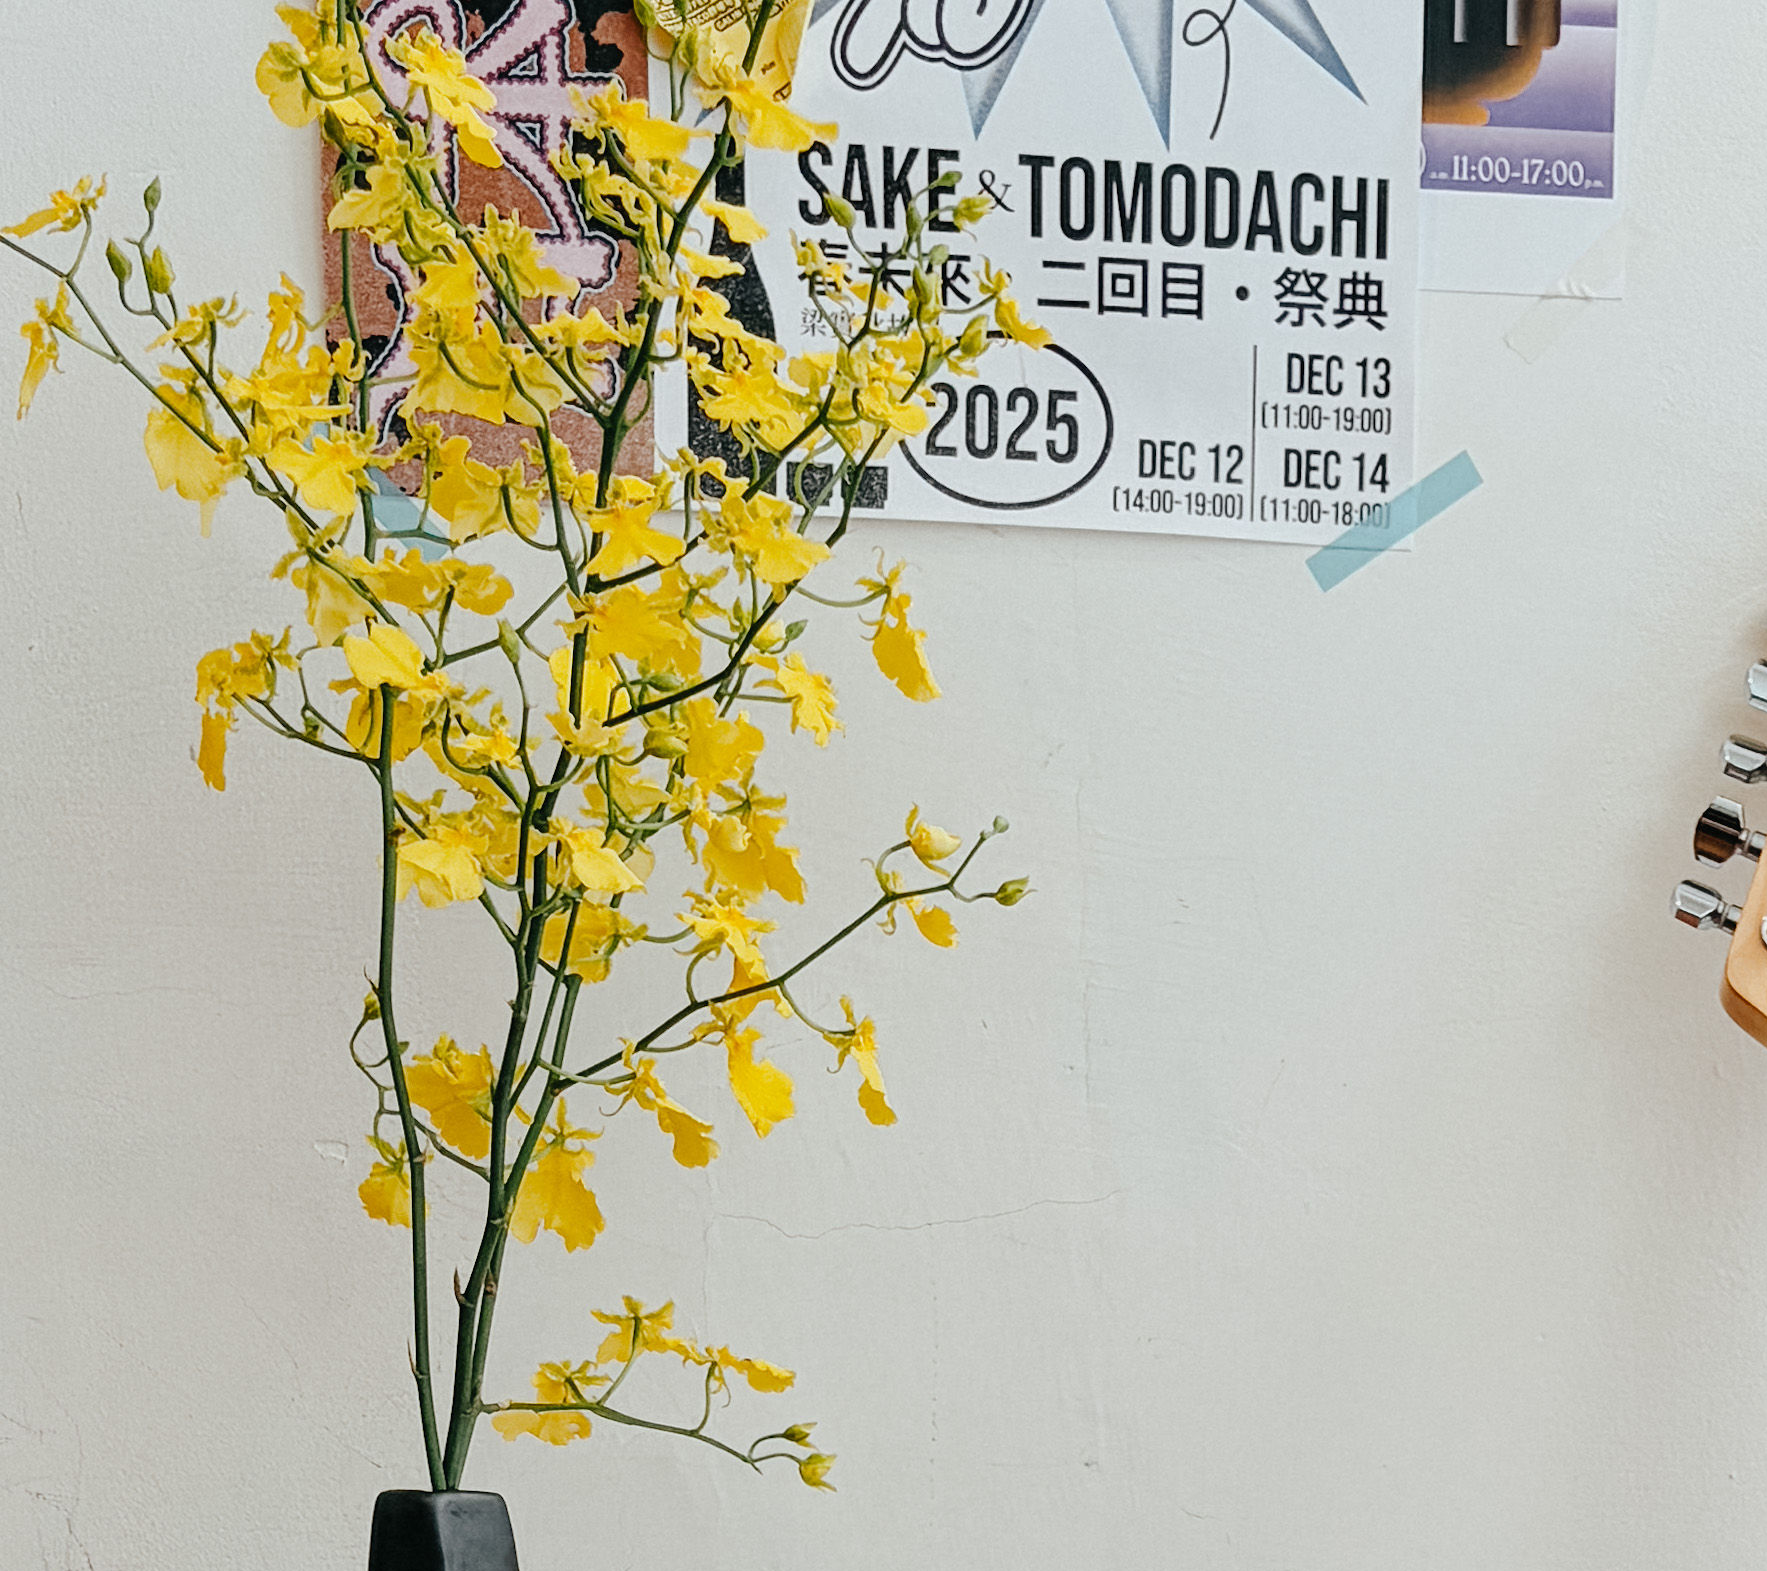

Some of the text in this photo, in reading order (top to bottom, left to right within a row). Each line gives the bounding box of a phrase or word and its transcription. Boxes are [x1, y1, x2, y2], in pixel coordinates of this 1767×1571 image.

[1452, 155, 1585, 187] 11:00-17:00
[798, 141, 1390, 259] SAKE & TOMODACHI
[1287, 354, 1391, 398] DEC 13
[926, 382, 1079, 463] 2025
[1139, 440, 1243, 484] DEC 12
[1284, 448, 1390, 492] DEC 14
